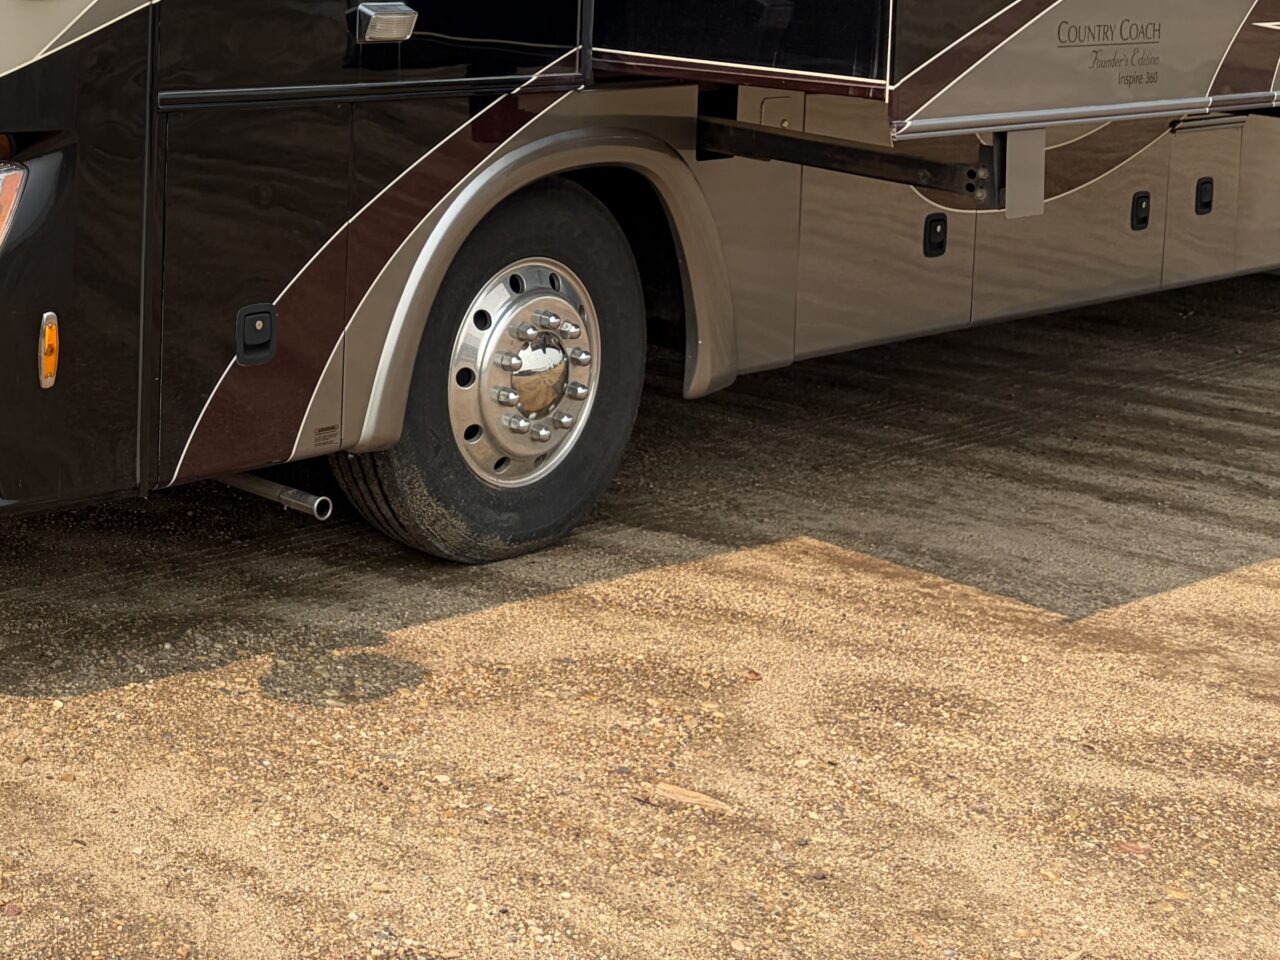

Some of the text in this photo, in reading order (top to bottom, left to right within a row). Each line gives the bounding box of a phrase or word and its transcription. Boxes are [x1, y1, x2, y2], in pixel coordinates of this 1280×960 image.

[1057, 18, 1161, 44] COUNTRY COACH
[1088, 47, 1160, 69] Founder's Edition
[1118, 71, 1158, 87] Inspire 360
